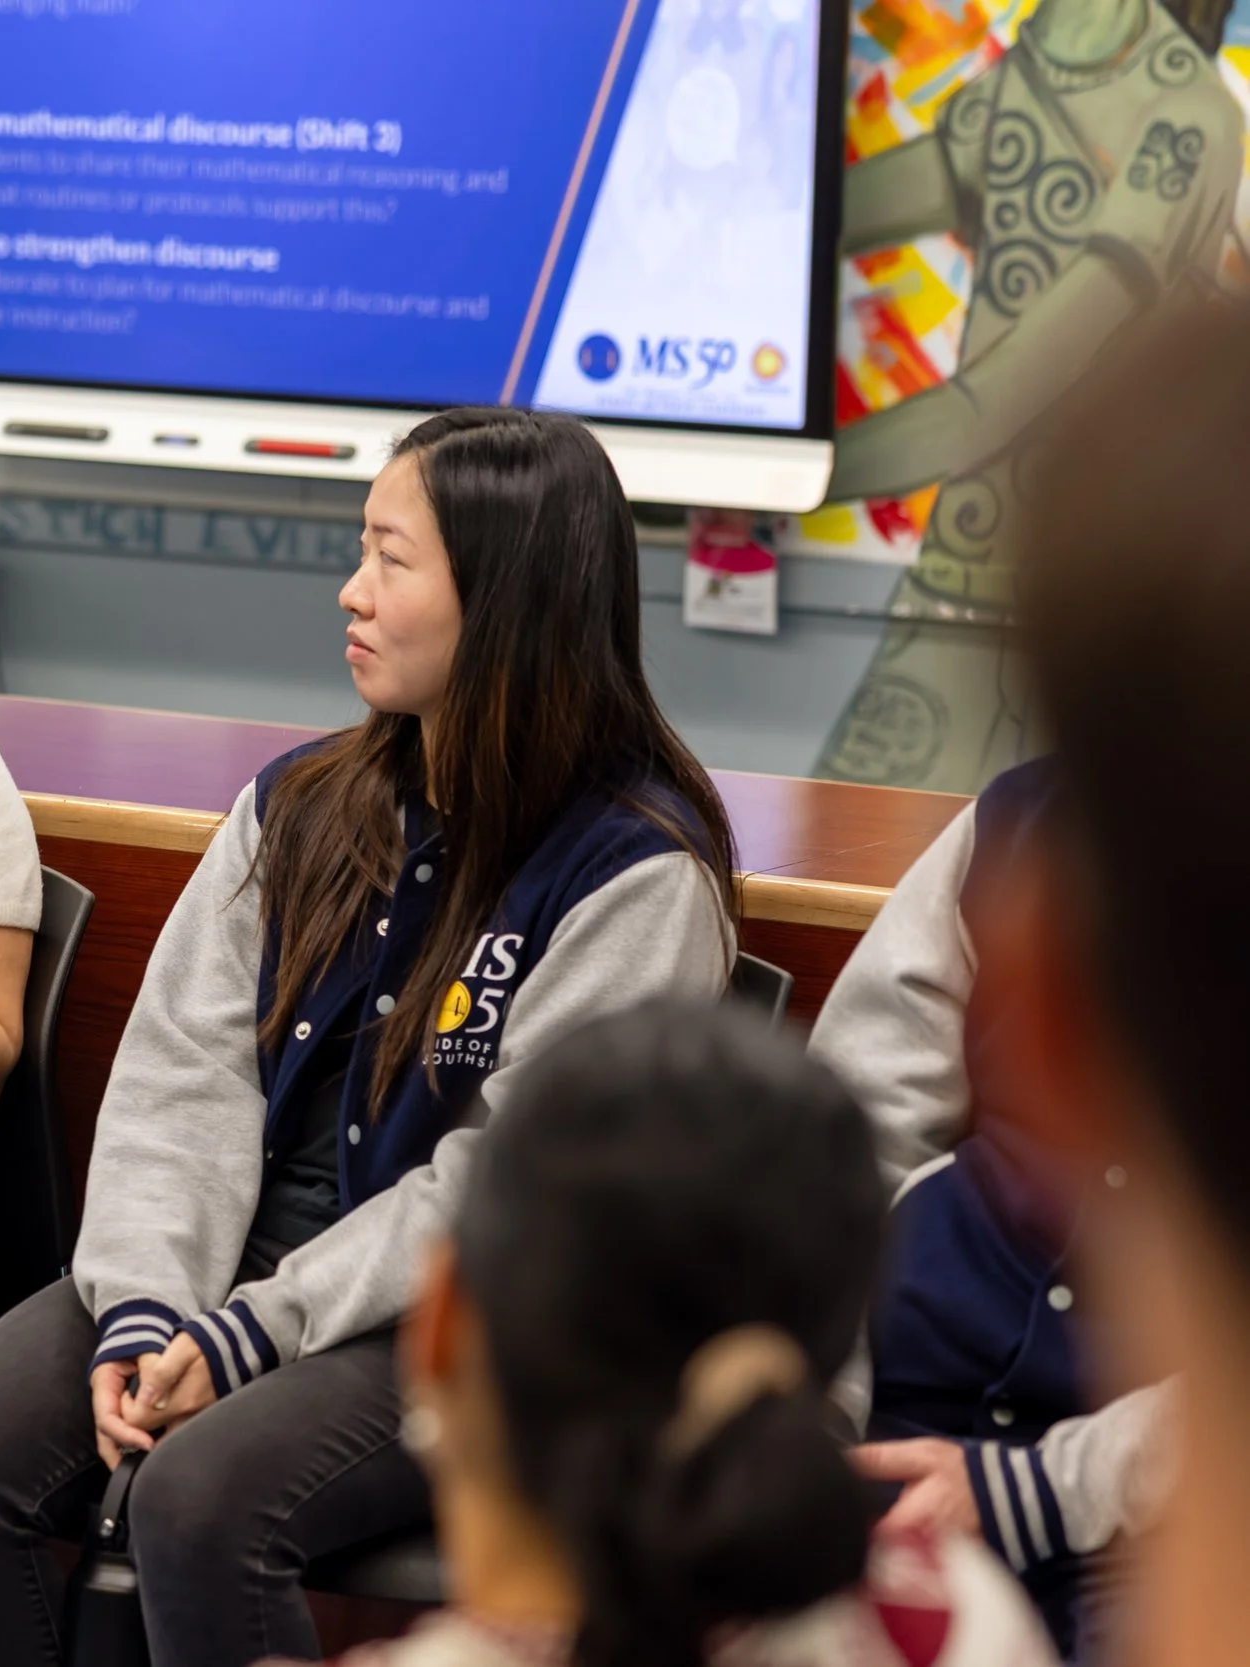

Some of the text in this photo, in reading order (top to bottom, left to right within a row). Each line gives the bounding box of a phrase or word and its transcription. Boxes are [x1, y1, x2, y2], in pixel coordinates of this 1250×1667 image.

[167, 113, 293, 148] discourse
[13, 230, 152, 268] strengthen
[155, 234, 280, 272] discourse
[465, 987, 512, 1033] 5
[422, 1053, 498, 1070] OUTHSI
[435, 1038, 491, 1054] IDE OF
